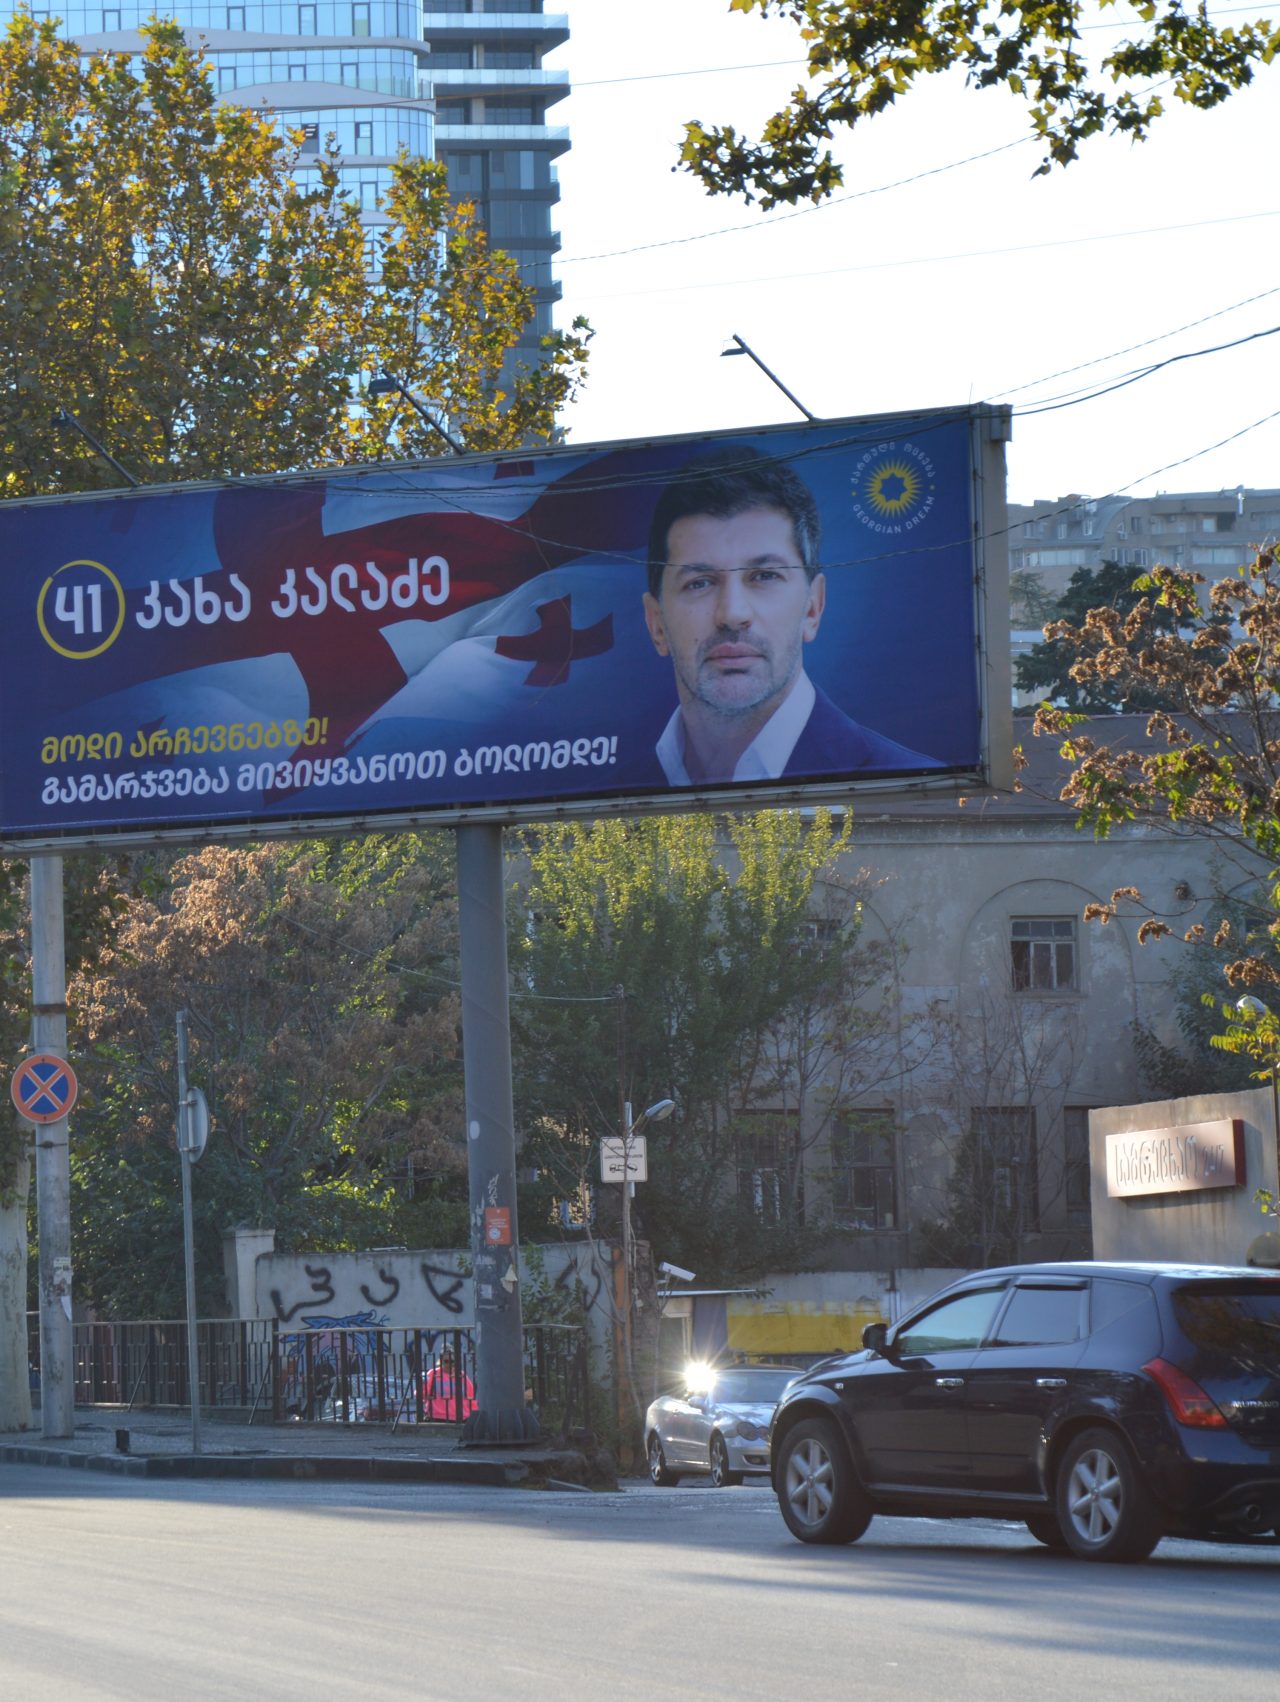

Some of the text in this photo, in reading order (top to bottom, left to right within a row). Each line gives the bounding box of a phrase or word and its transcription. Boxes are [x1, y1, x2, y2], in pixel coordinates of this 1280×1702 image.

[853, 496, 935, 534] GEORGIAN DREAM
[135, 555, 450, 630] კახა კალაძე
[41, 717, 329, 764] მოდი არჩევნებზე!
[41, 735, 619, 805] გამარჯვება მივიყვანოთ ბოლომდე!
[1231, 1400, 1279, 1408] MURANO
